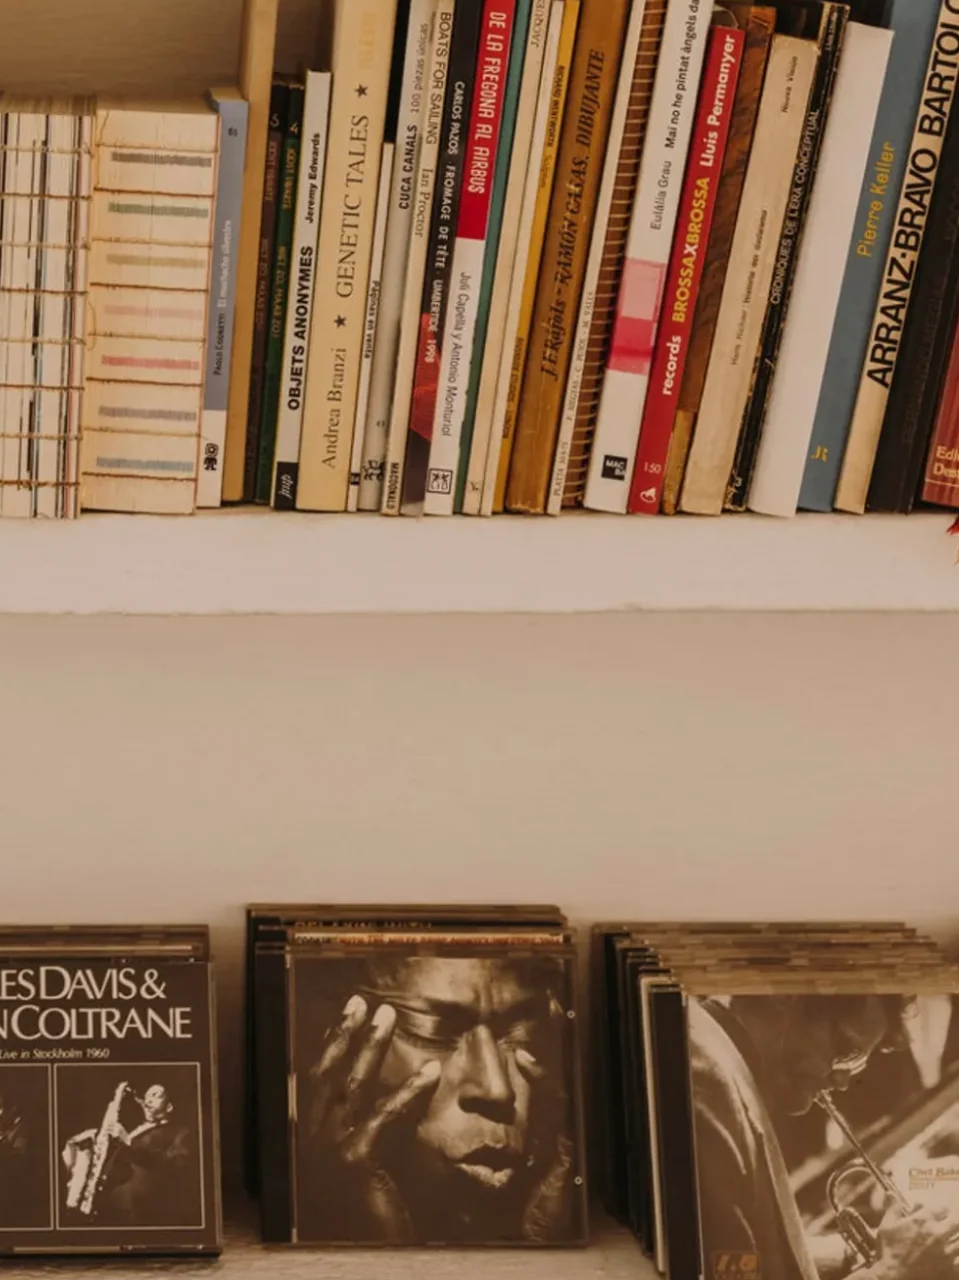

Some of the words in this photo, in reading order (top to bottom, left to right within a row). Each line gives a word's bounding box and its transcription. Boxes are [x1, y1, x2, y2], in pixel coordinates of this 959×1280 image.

[435, 11, 452, 57] BOATS
[489, 11, 507, 29] DE
[680, 15, 698, 54] àngels
[486, 34, 504, 51] LA
[411, 59, 425, 91] piezas
[432, 60, 447, 90] FOR
[478, 57, 502, 117] FREGONA
[675, 56, 691, 91] pintat
[409, 94, 420, 114] 100
[451, 80, 466, 120] CARLOS
[574, 48, 607, 149] DIBUJANTE
[669, 110, 682, 125] no
[672, 93, 685, 108] he
[425, 93, 443, 145] SAILING
[447, 122, 462, 155] PAZOS
[475, 123, 493, 141] AL
[664, 126, 679, 149] Mai
[307, 132, 321, 181] Edwards
[345, 114, 370, 188] TALES
[401, 124, 418, 173] CANALS
[869, 140, 896, 195] Keller
[420, 168, 434, 188] Ian
[467, 146, 491, 195] AIRBUS
[657, 160, 672, 188] Grau
[784, 220, 797, 236] DE
[794, 108, 820, 184] CONCEPTUAL
[304, 183, 319, 224] Jeremy
[398, 176, 413, 210] CUCA
[440, 165, 457, 221] FROMAGE
[414, 191, 431, 238] Proctor
[437, 226, 450, 239] DE
[662, 335, 682, 396] records
[706, 34, 736, 126] Permanyer
[856, 200, 883, 258] Pierre
[335, 194, 362, 298] GENETIC
[293, 246, 314, 341] ANONYMES
[459, 272, 473, 291] Juli
[451, 293, 470, 331] Capella
[424, 338, 438, 364] 1998
[446, 342, 463, 384] Antonio
[288, 345, 305, 411] OBJETS
[326, 348, 347, 402] Branzi
[441, 385, 458, 437] Monturiol
[321, 408, 341, 470] Andrea
[386, 462, 400, 510] MACDONALD
[39, 966, 137, 1000] DAVIS
[140, 968, 167, 1000] &
[10, 1004, 192, 1040] COLTRANE
[20, 1048, 30, 1059] in
[32, 1048, 83, 1060] Stockholm
[86, 1048, 110, 1060] 1960
